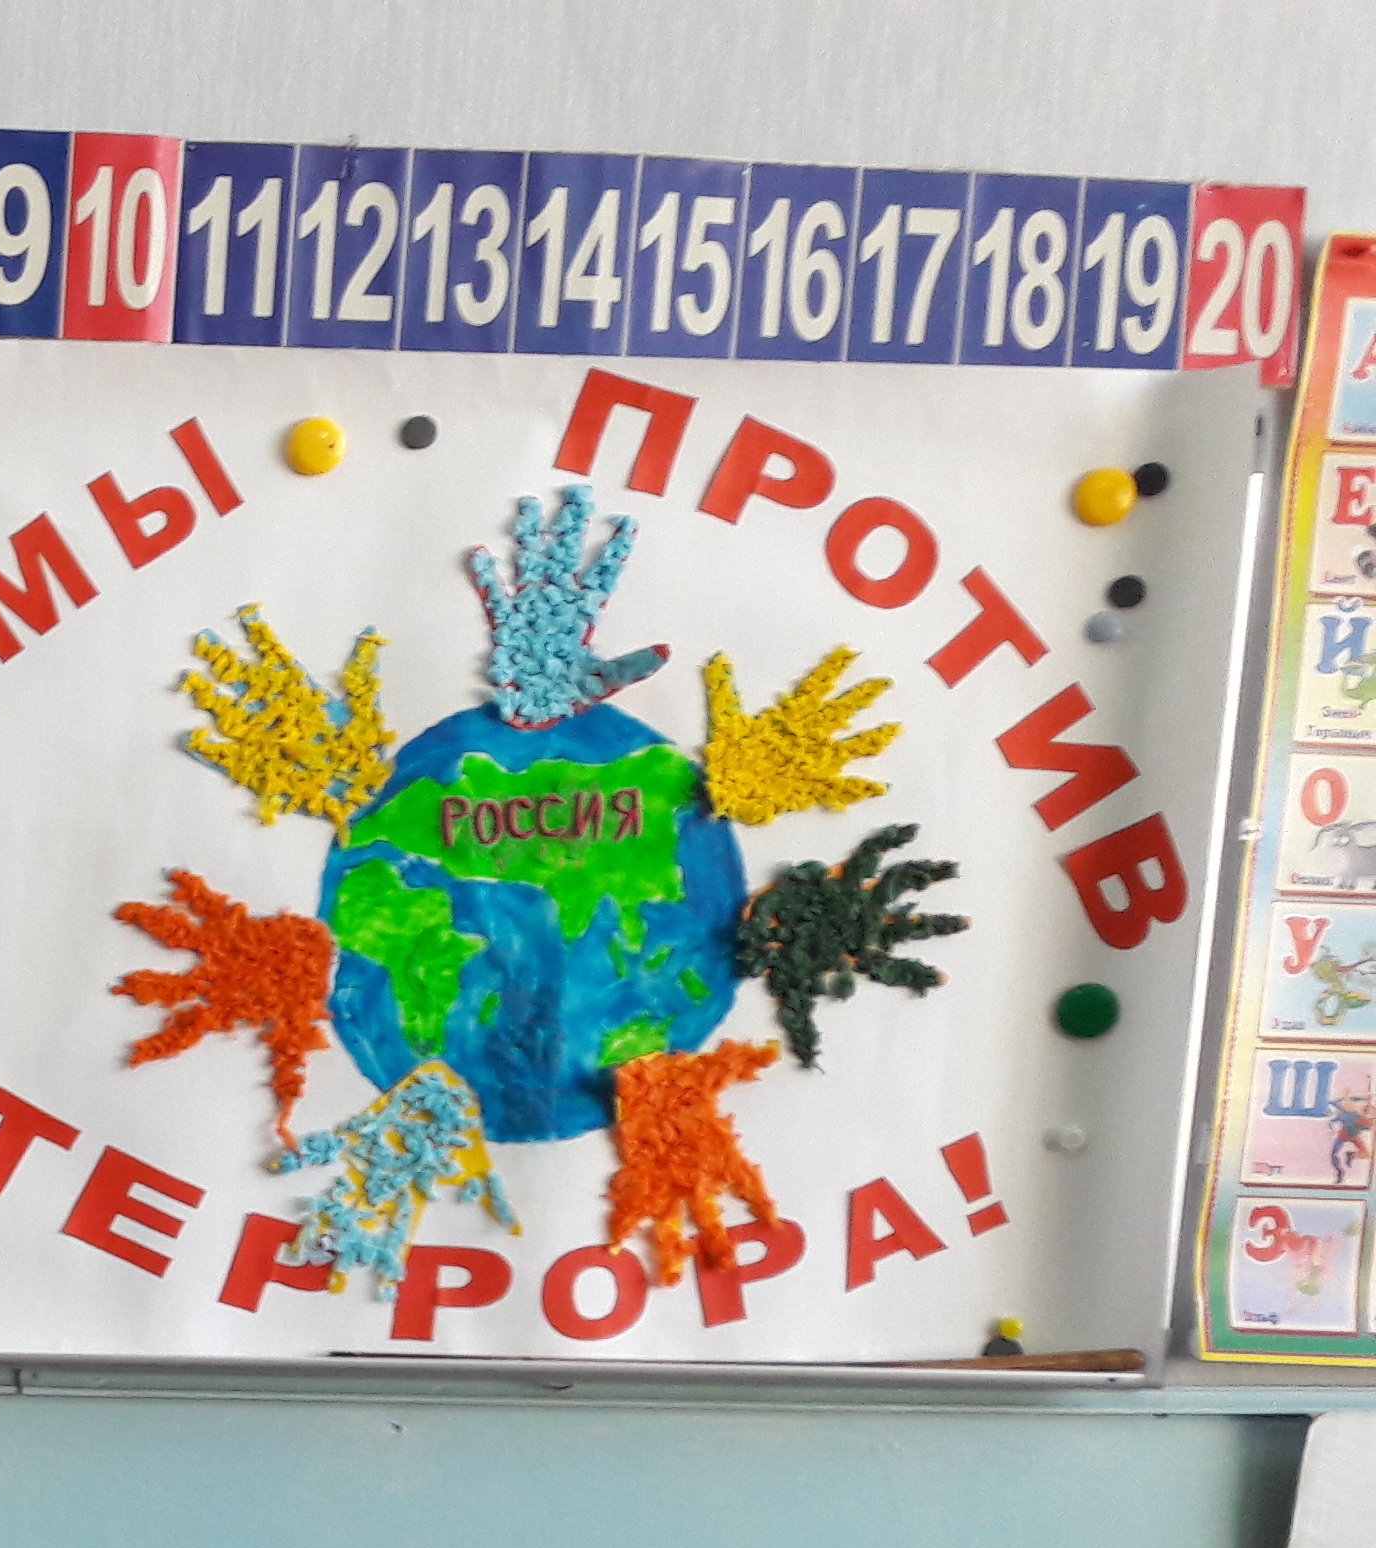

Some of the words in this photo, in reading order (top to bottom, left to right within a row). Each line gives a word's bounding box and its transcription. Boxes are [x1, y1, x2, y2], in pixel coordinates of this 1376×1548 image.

[76, 166, 167, 308] 10
[187, 176, 281, 317] 11
[298, 181, 398, 321] 12
[411, 183, 510, 326] 13
[526, 187, 624, 329] 14
[640, 192, 738, 338] 15
[748, 198, 848, 344] 16
[860, 204, 962, 349] 17
[972, 208, 1068, 350] 18
[1083, 215, 1179, 354] 19
[1189, 220, 1294, 358] 20
[553, 367, 1189, 950] ПРОТИВ
[1317, 598, 1372, 673] Й
[441, 787, 644, 848] РОССИЯ
[1301, 767, 1348, 827] О
[1283, 916, 1332, 975] У
[1263, 1059, 1335, 1117] Ш
